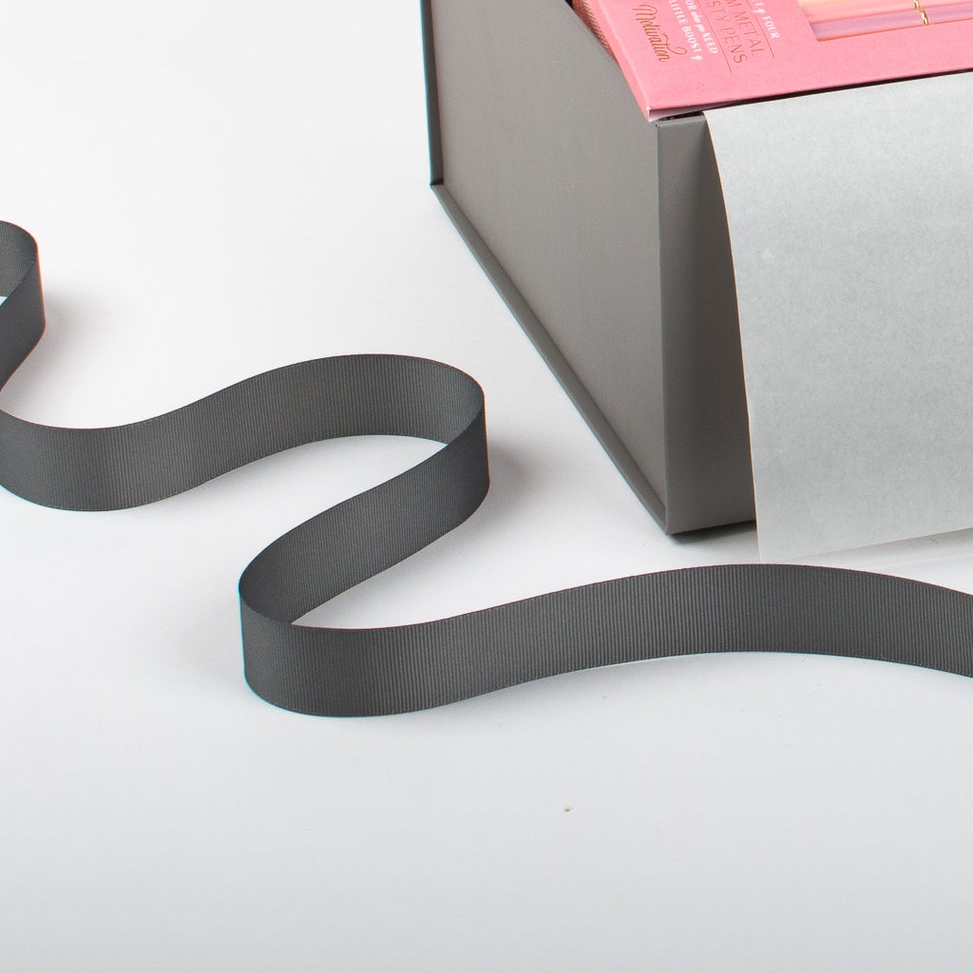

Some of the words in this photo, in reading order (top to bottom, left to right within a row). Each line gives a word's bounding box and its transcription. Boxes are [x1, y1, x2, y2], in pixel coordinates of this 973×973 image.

[631, 4, 688, 62] Motivation
[668, 0, 688, 25] LITTLE
[681, 25, 702, 53] BOOST
[702, 32, 719, 54] NEED
[719, 26, 748, 64] PENS
[734, 11, 765, 57] METAL
[762, 15, 780, 39] FOUR
